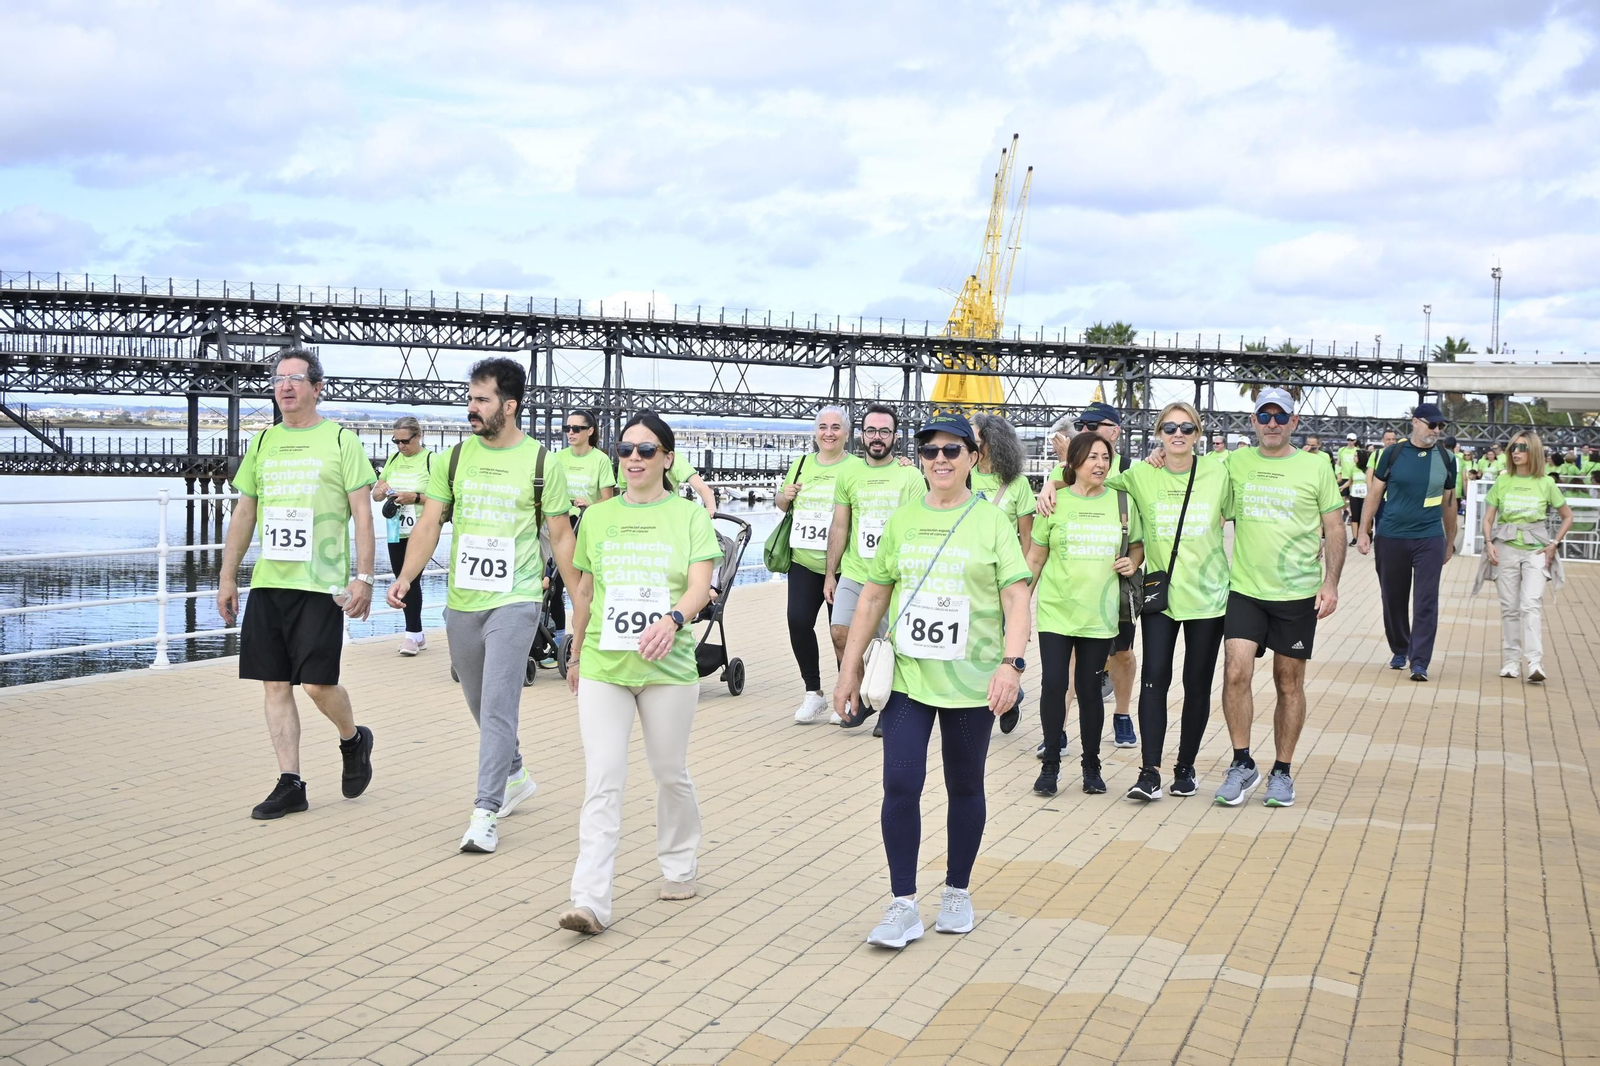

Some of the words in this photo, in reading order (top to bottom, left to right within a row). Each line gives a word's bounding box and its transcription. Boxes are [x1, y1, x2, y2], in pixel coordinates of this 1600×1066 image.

[265, 459, 277, 468] En
[281, 458, 322, 466] marcha
[263, 470, 304, 481] contra
[307, 468, 320, 479] el
[264, 482, 320, 496] cáncer
[464, 480, 477, 490] En
[480, 482, 521, 496] marcha
[870, 490, 900, 498] marcha
[1245, 482, 1256, 491] En
[1258, 484, 1297, 496] marcha
[463, 494, 503, 506] contra
[505, 497, 517, 508] el
[797, 498, 834, 511] cánce
[1242, 494, 1280, 506] contra
[1282, 499, 1293, 508] el
[463, 504, 518, 523] cáncer
[858, 508, 894, 518] cánce
[1198, 512, 1209, 522] el
[1244, 504, 1293, 519] cáncer
[795, 522, 827, 540] 2134
[1068, 522, 1080, 530] En
[1083, 524, 1120, 532] marcha
[265, 524, 307, 548] 2135
[1059, 522, 1067, 560] HUELVA
[1067, 533, 1106, 542] contra
[1109, 534, 1120, 544] el
[604, 541, 620, 551] En
[623, 541, 672, 553] marcha
[900, 543, 916, 554] En
[1068, 542, 1114, 556] cánce
[461, 552, 508, 578] 2703
[602, 552, 652, 567] contra
[654, 555, 669, 568] el
[950, 561, 965, 574] el
[604, 566, 669, 585] cáncer
[901, 571, 965, 593] cáncer
[904, 612, 959, 644] 1861
